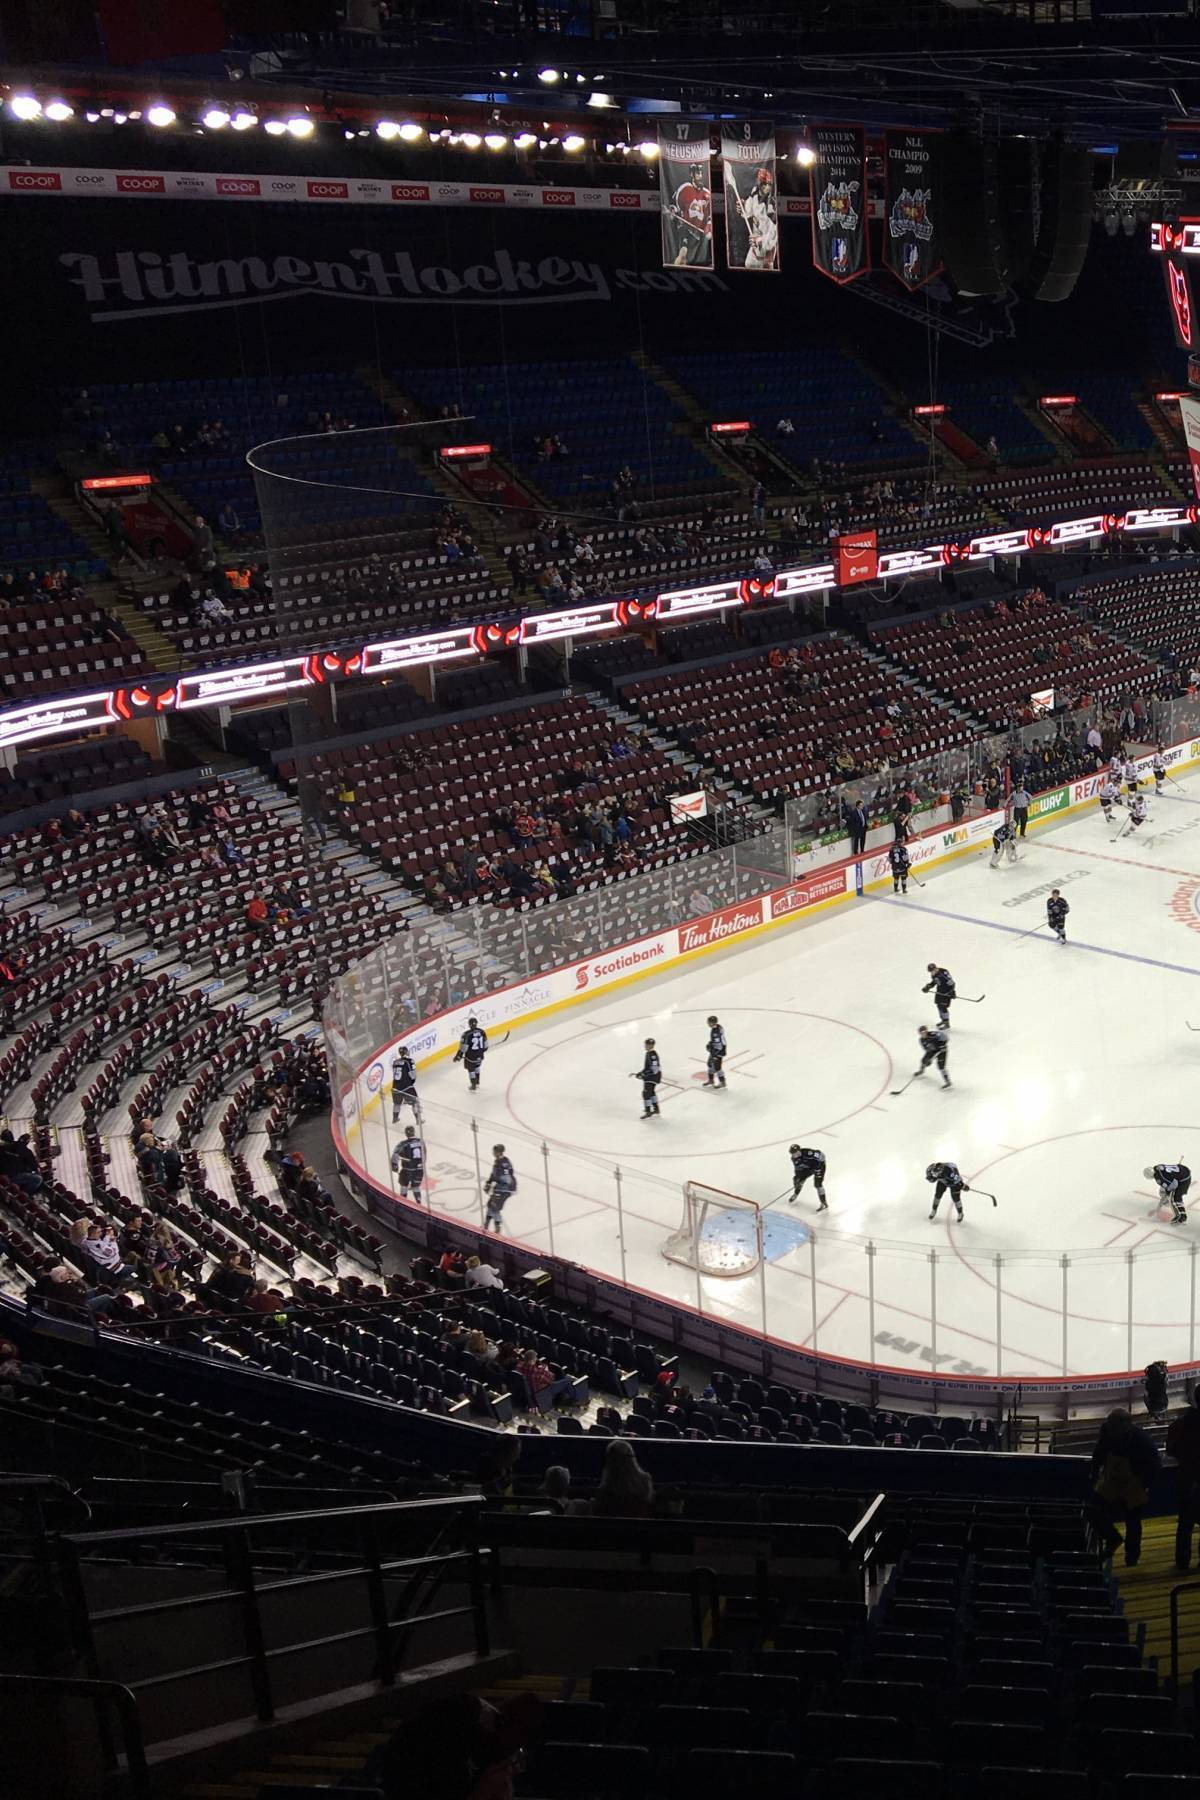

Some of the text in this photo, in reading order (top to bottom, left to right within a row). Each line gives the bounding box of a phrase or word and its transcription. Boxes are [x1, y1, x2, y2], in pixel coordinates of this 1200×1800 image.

[676, 124, 690, 140] 17
[743, 124, 751, 139] 9
[817, 131, 856, 142] WESTERN
[819, 143, 856, 154] DIVISION
[905, 136, 924, 148] NLL
[737, 144, 761, 160] TOTH
[889, 150, 930, 163] CHAMPIO
[16, 176, 55, 186] CO-OP
[75, 176, 105, 184] CO-OP
[122, 179, 160, 190] CO-OP
[222, 182, 255, 192] CO-OP
[312, 185, 344, 195] CO-OP
[396, 187, 425, 198] CO-OP
[61, 248, 728, 302] HitmenHockey.com
[1075, 778, 1106, 801] RE/M
[1027, 793, 1064, 817] UBWAY
[943, 829, 968, 846] WM
[681, 912, 760, 950] Tim Hortons
[594, 944, 664, 978] Scotiabank
